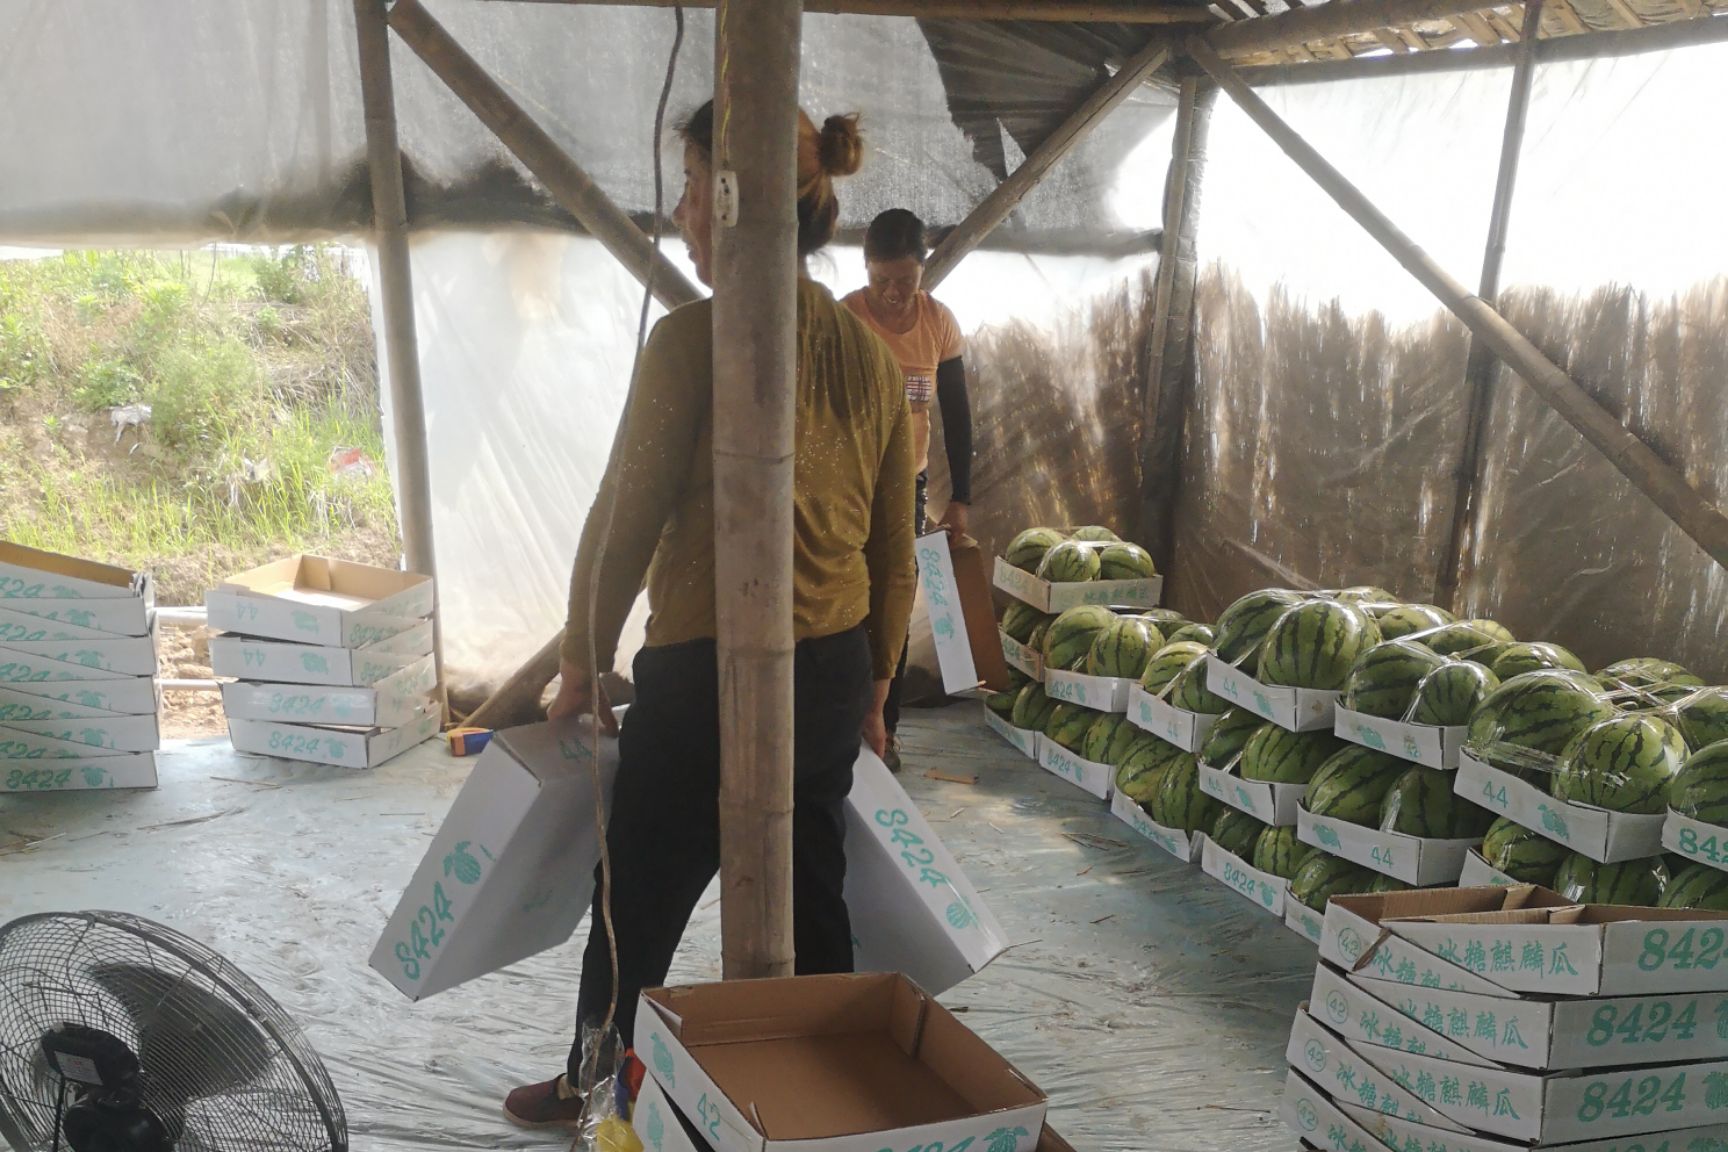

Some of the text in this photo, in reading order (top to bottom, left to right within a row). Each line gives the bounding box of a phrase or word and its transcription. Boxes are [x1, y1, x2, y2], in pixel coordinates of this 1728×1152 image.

[269, 692, 326, 715] 8424
[1223, 677, 1238, 698] 44
[267, 730, 320, 752] 8424
[6, 769, 72, 789] 8424
[1482, 780, 1509, 808] 44
[874, 808, 952, 888] 8424
[1370, 846, 1394, 869] 44
[1223, 862, 1256, 894] 8424
[395, 881, 455, 982] 8424
[1637, 926, 1728, 972] 842
[1586, 1000, 1698, 1047] 8424
[1577, 1071, 1687, 1123] 8424
[697, 1092, 721, 1142] 42
